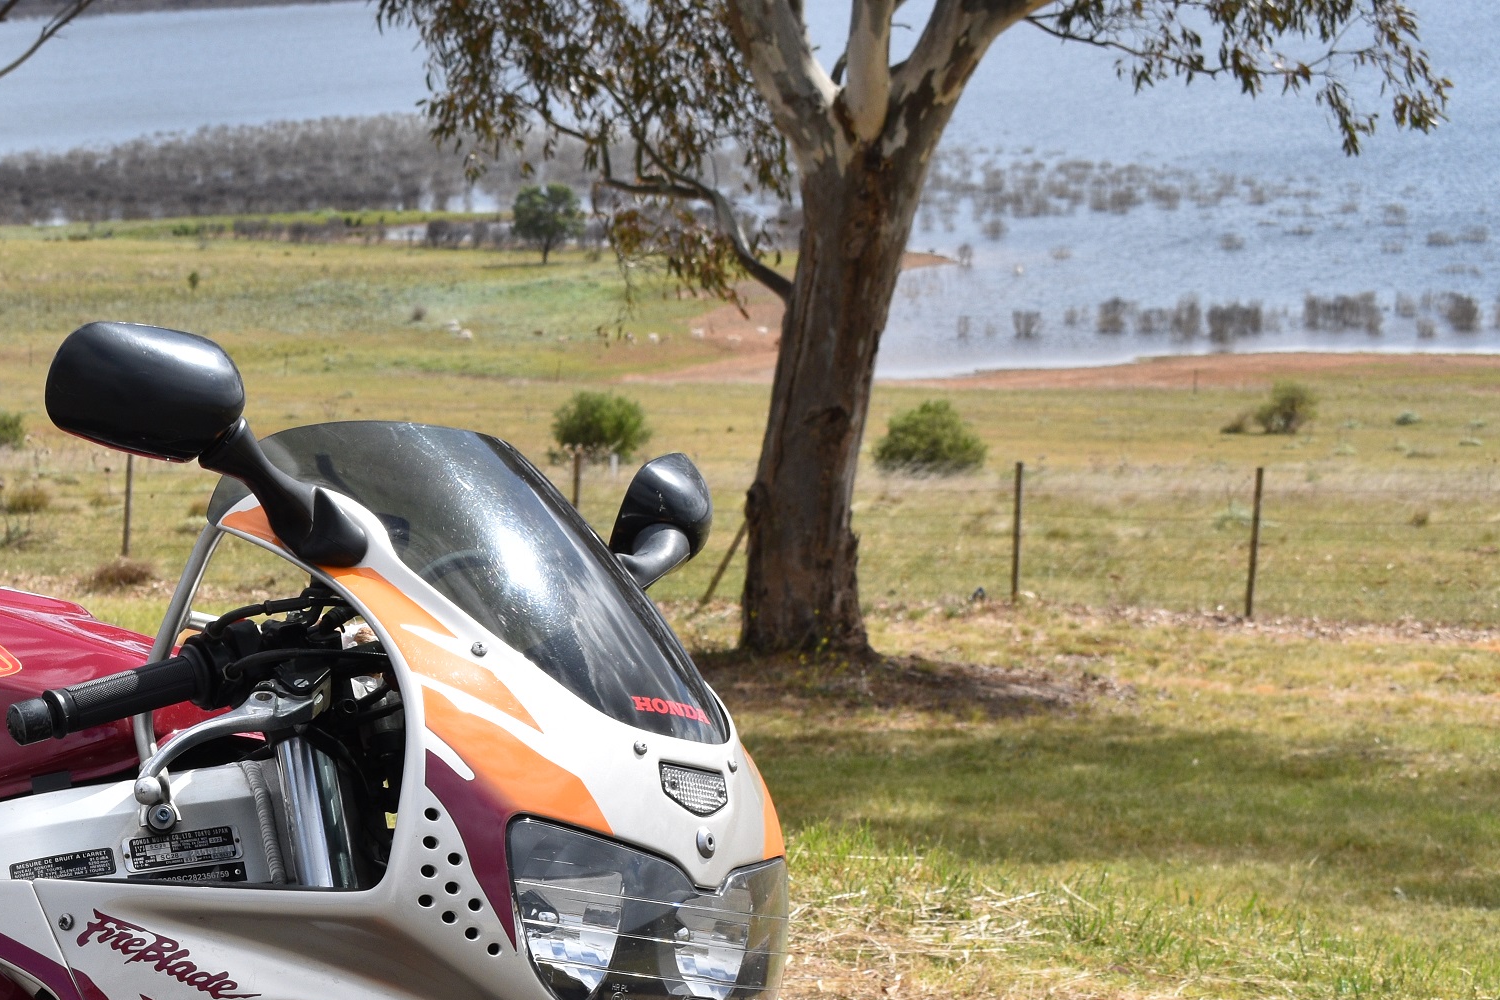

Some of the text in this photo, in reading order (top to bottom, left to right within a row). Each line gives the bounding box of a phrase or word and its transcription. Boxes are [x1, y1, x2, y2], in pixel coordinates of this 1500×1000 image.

[631, 696, 711, 725] HONDA
[132, 838, 150, 846] HONDA
[212, 827, 229, 835] JAPAN
[16, 860, 42, 870] MESURE
[55, 854, 74, 863] BRUIT
[76, 908, 262, 999] FireBlade
